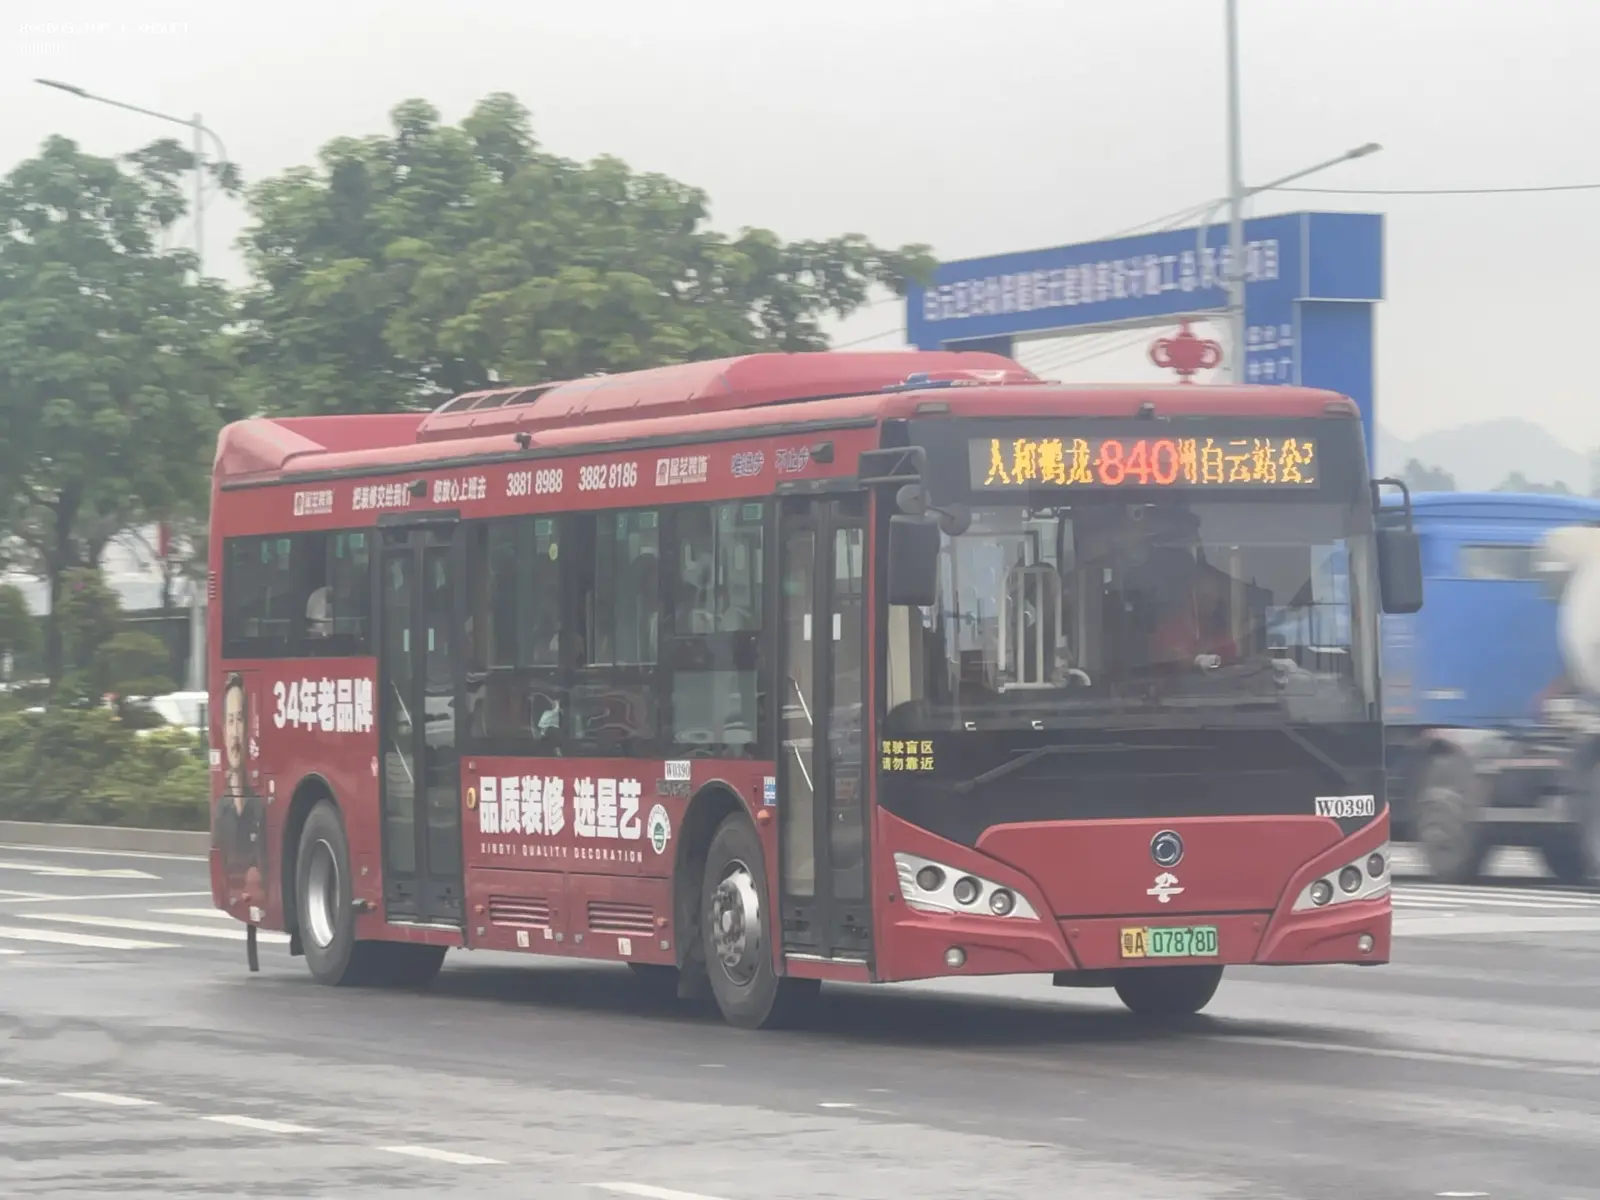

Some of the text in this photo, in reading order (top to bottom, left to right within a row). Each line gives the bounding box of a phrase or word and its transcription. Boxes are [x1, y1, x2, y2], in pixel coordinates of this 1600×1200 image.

[775, 446, 810, 475] 不止步
[1098, 440, 1179, 485] 840
[506, 462, 638, 497] 3881 8988 3882 8186
[273, 676, 374, 733] 34年老品牌
[882, 740, 934, 755] 驾驶盲区
[666, 762, 691, 779] W0390
[882, 757, 934, 771] 请勿靠近
[479, 775, 565, 836] 品质装修
[573, 777, 642, 840] 选星艺
[1317, 798, 1374, 818] W0390
[522, 844, 567, 859] QUALITY
[574, 847, 643, 864] DECORATION
